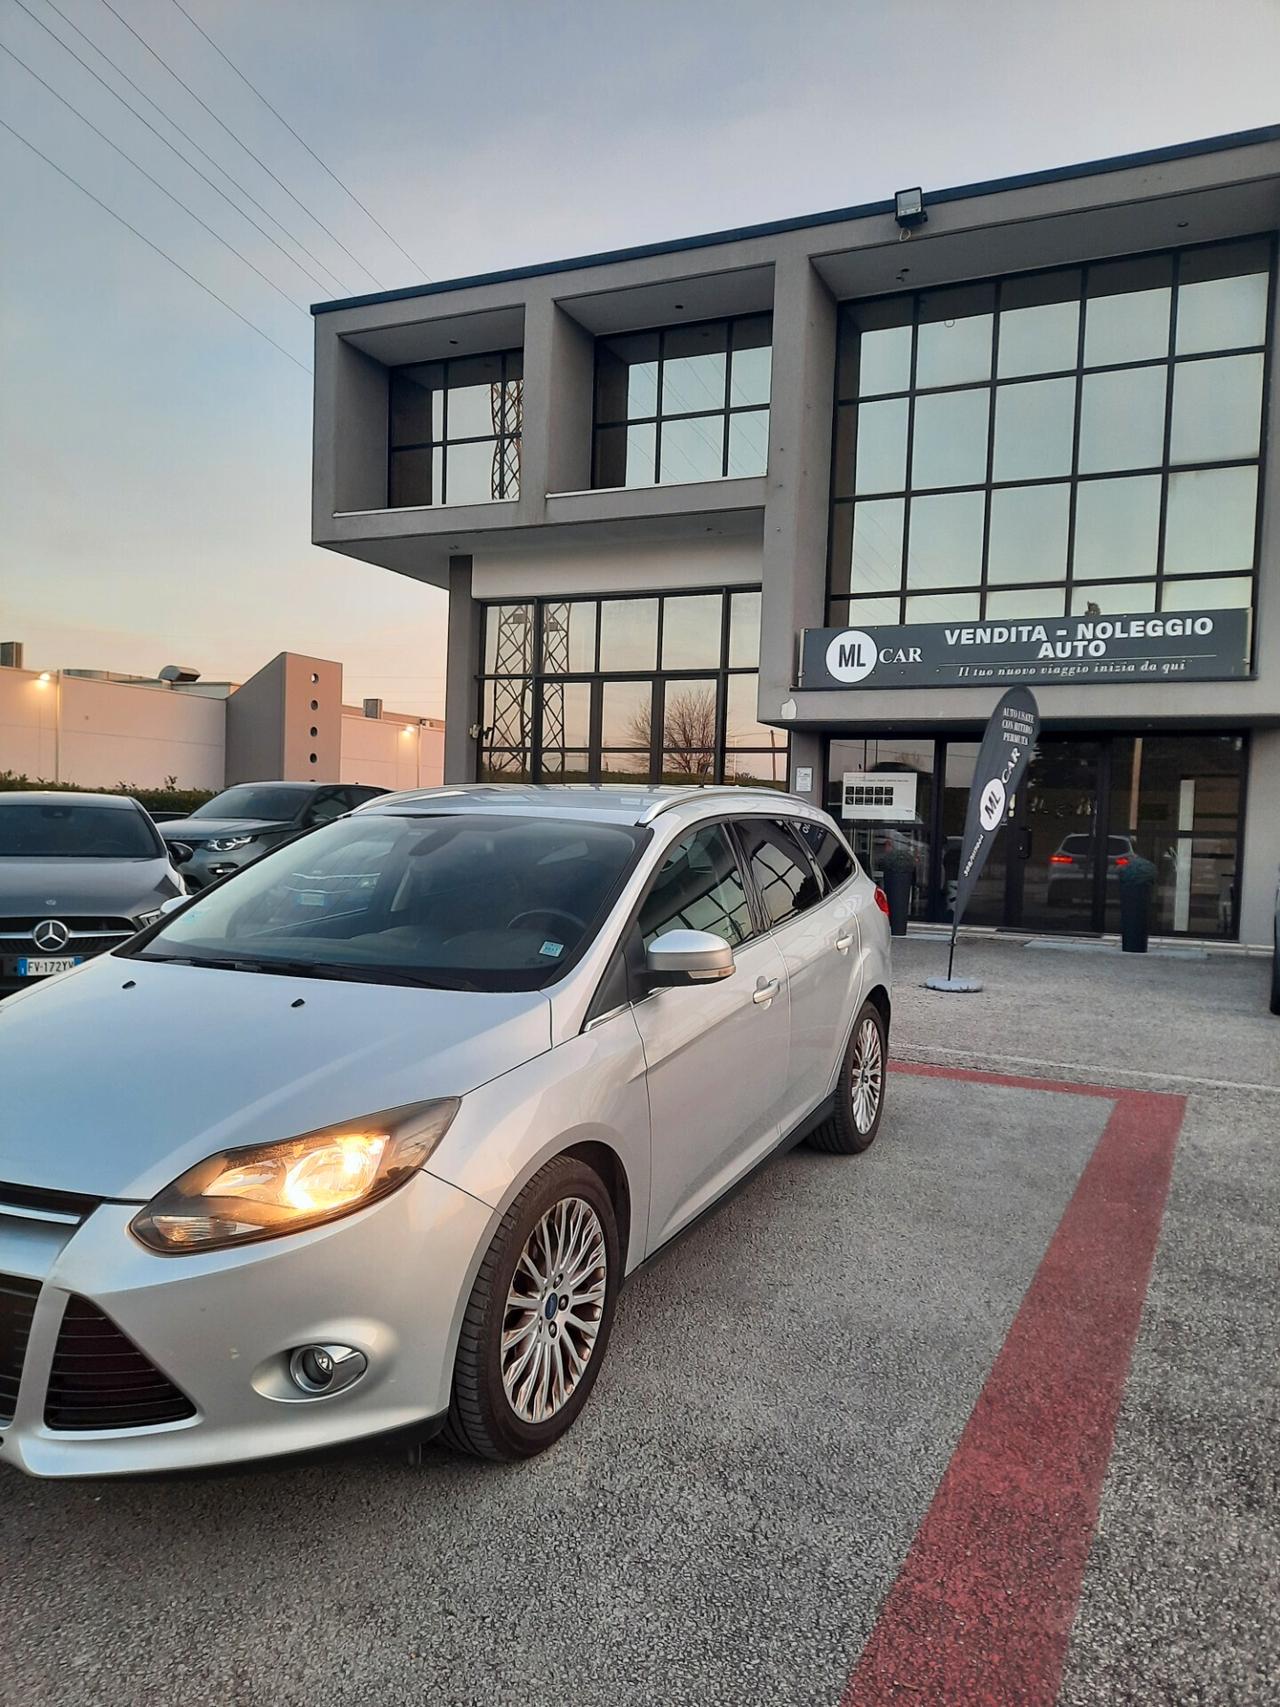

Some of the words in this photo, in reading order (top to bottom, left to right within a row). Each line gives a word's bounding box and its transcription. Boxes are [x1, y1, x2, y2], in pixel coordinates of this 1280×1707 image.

[944, 625, 1048, 645] VENDITA
[1076, 617, 1214, 640] NOLEGGIO
[838, 643, 867, 668] ML
[878, 647, 923, 664] CAR
[1037, 639, 1107, 659] AUTO
[958, 666, 970, 677] Il
[973, 666, 994, 676] tuo
[998, 666, 1037, 676] nuovo
[1041, 663, 1090, 677] viaggio
[1094, 661, 1136, 674] inizia
[1140, 660, 1158, 672] da
[1162, 659, 1187, 674] qui
[984, 791, 1002, 820] ML
[1001, 747, 1021, 784] CAR
